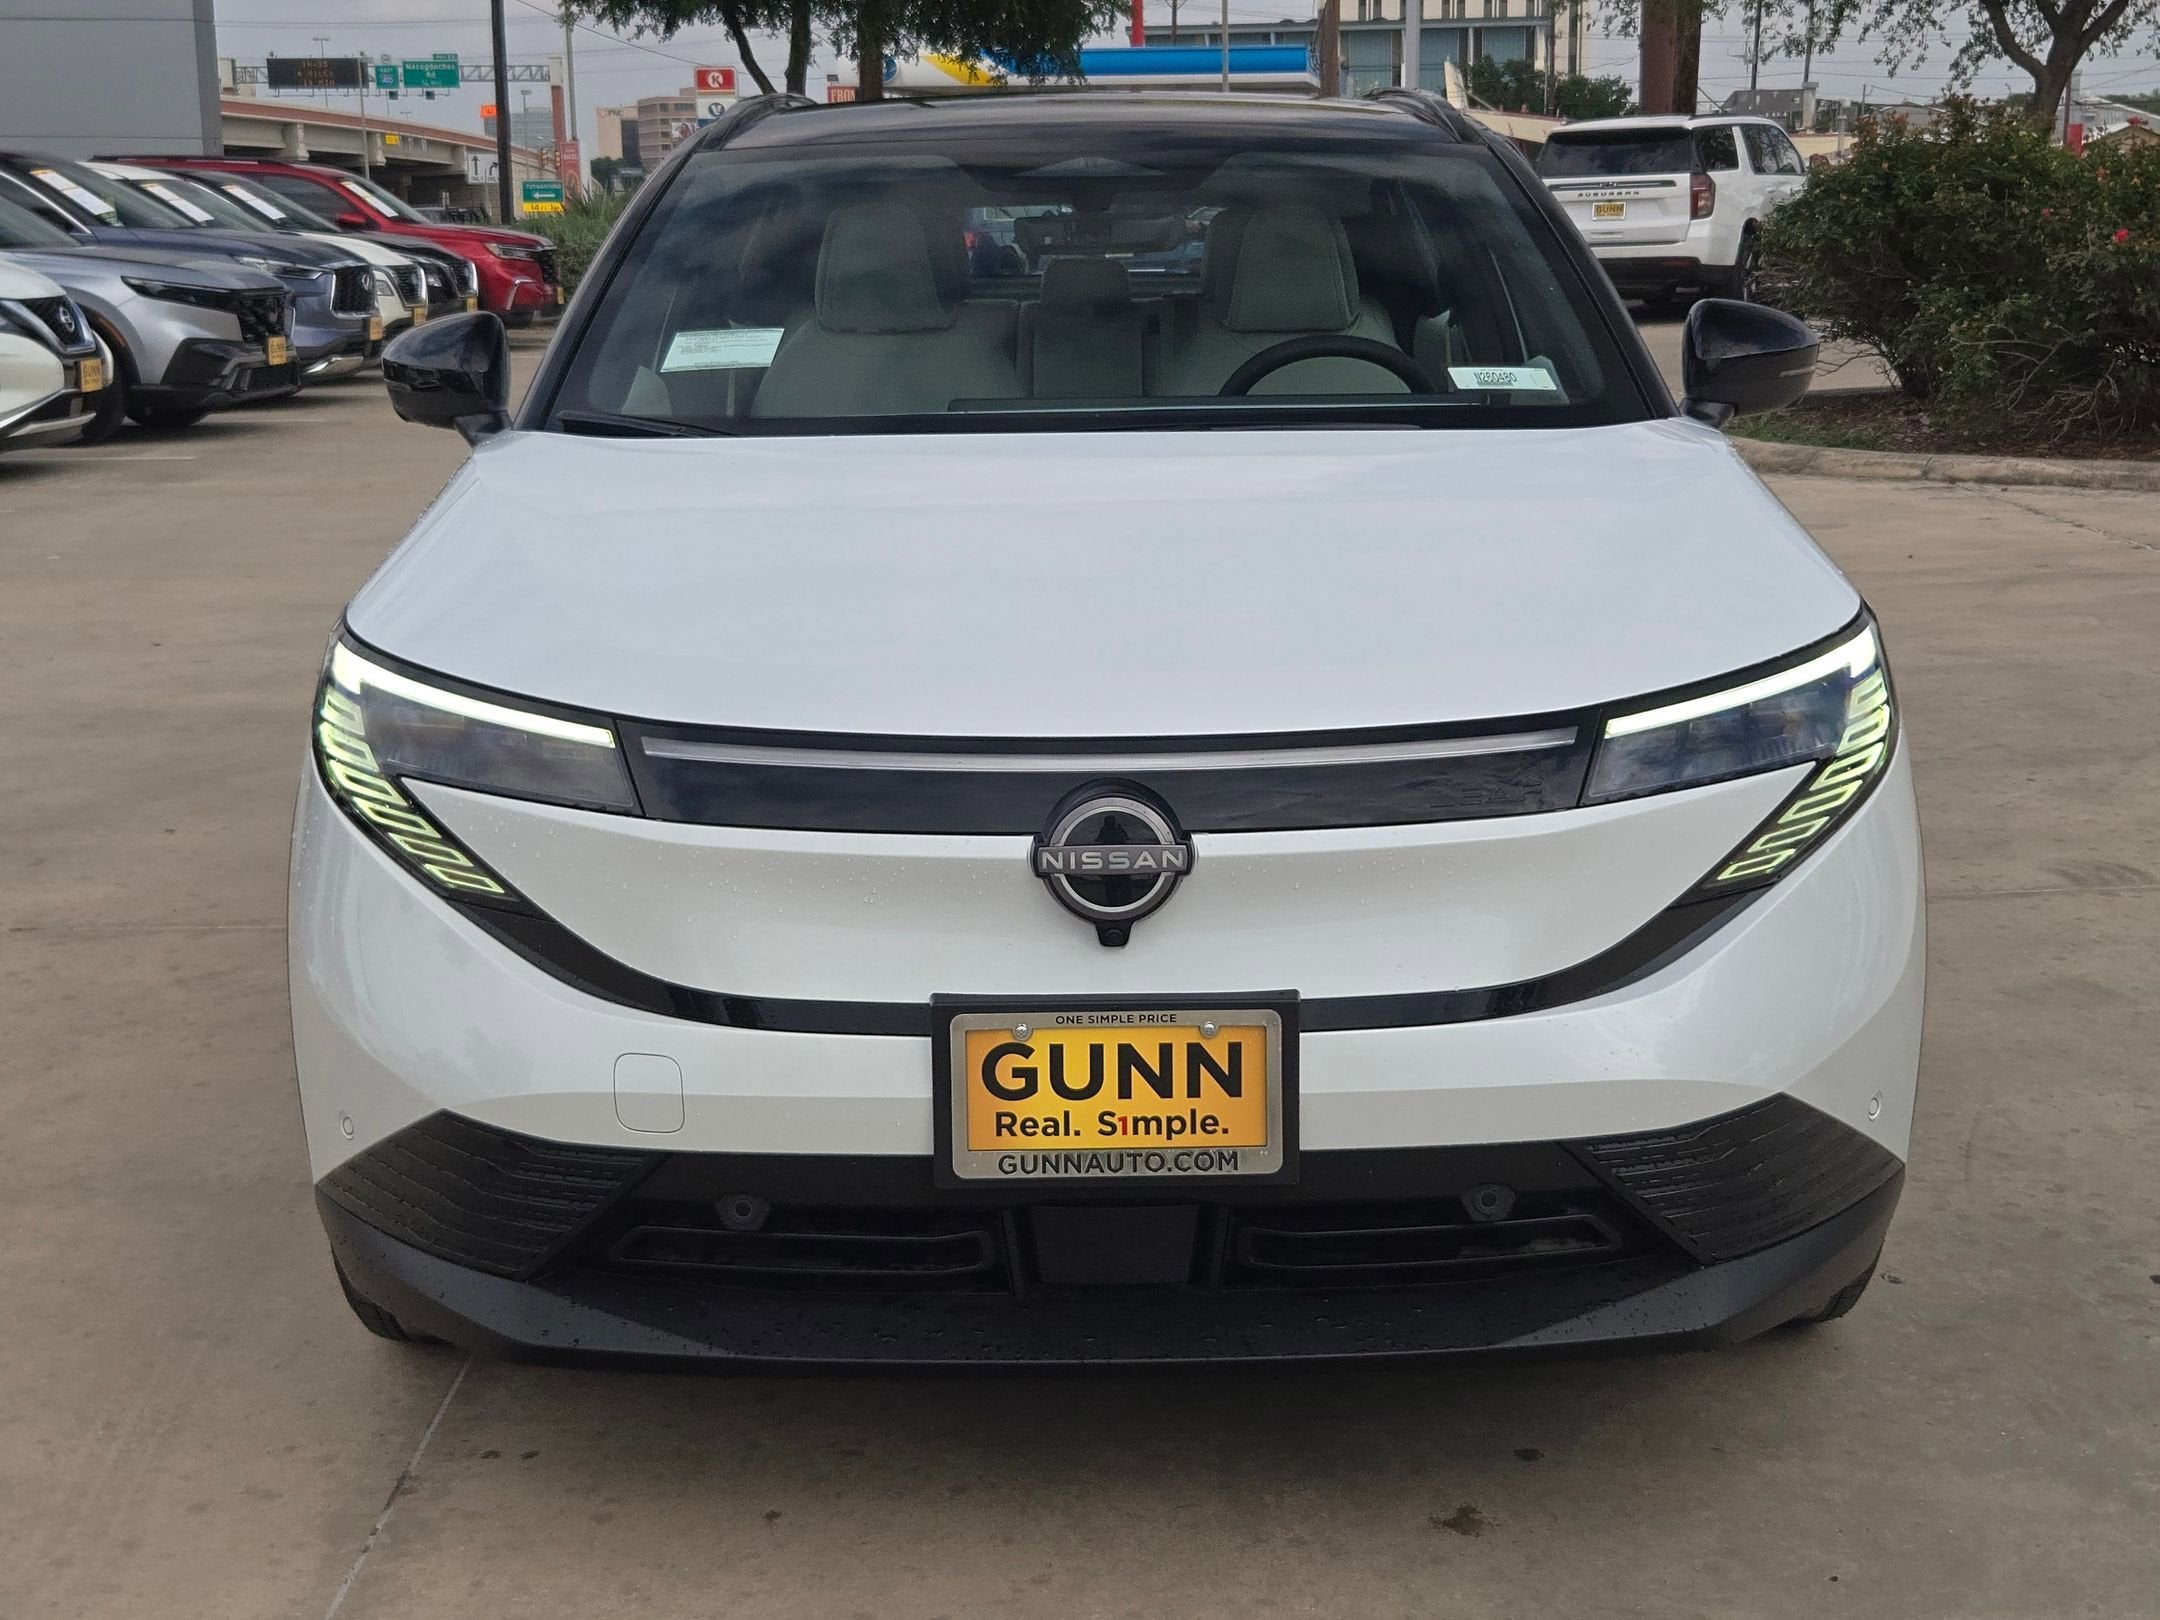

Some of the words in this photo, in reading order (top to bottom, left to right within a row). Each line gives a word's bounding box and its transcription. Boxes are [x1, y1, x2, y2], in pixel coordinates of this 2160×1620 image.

[426, 71, 436, 79] Rd
[1596, 204, 1623, 213] GUNN
[1042, 850, 1183, 870] NISSAN
[1055, 1015, 1084, 1025] ONE
[1087, 1014, 1135, 1024] SIMPLE
[1138, 1013, 1177, 1023] PRICE
[981, 1041, 1242, 1102] GUNN
[995, 1110, 1081, 1137] Real.
[998, 1150, 1239, 1176] GUNNAUTO.COM
